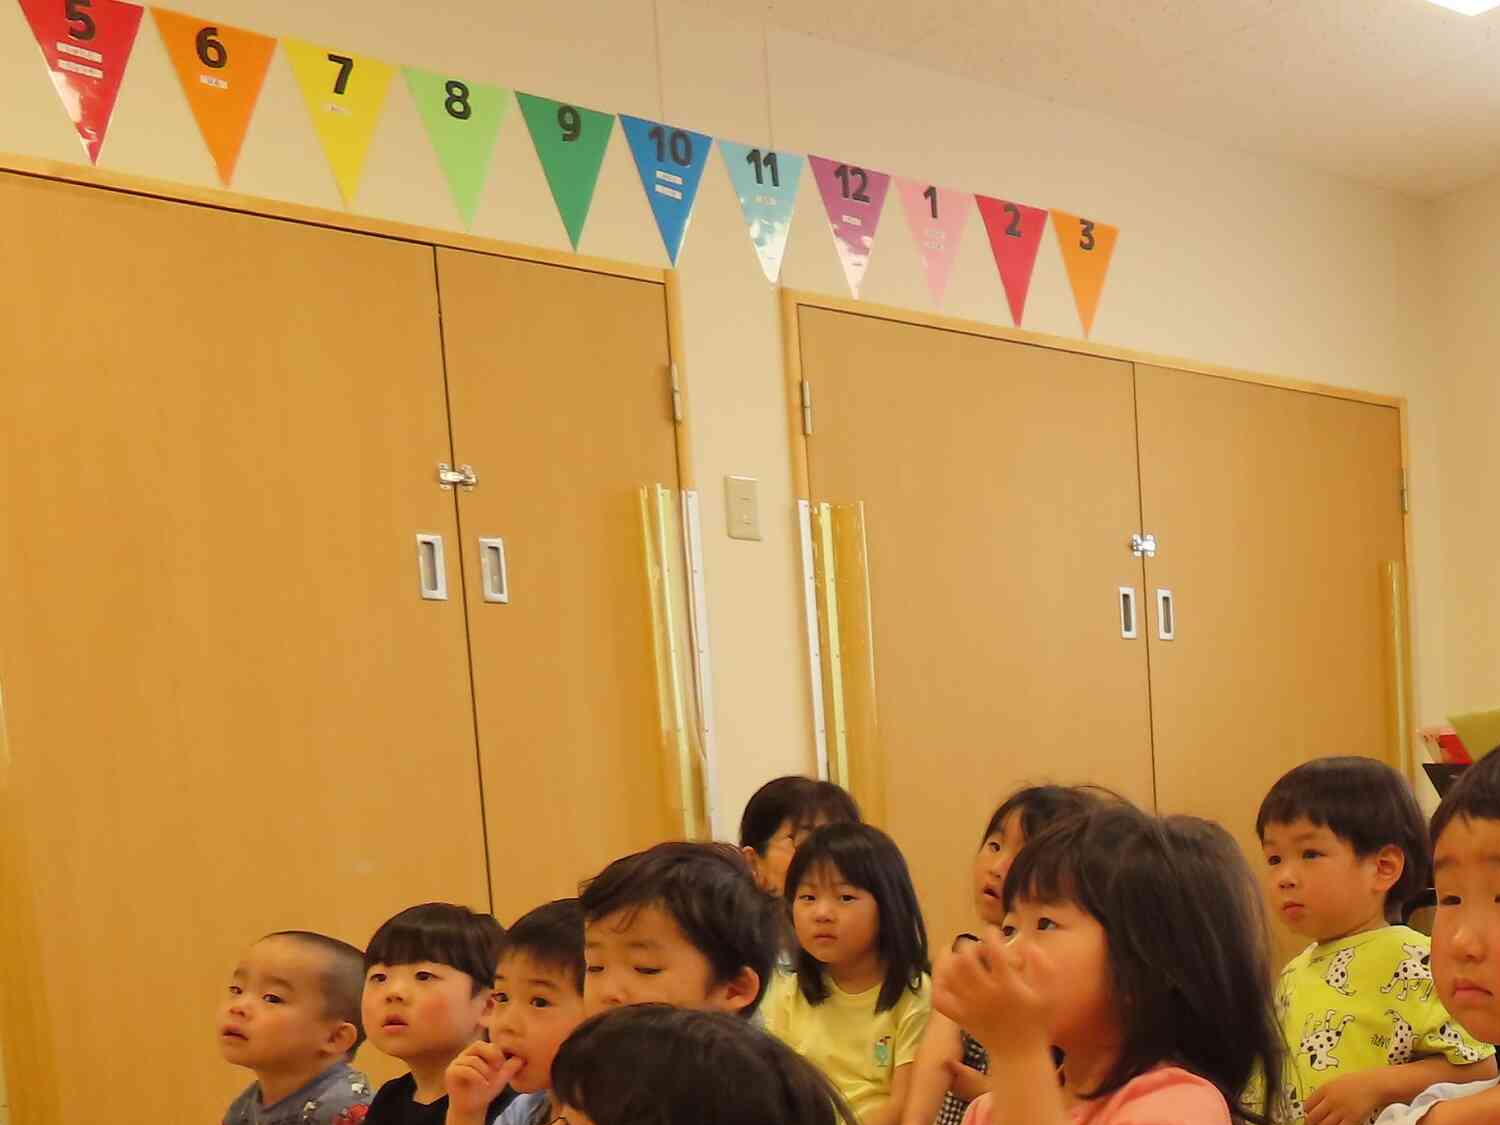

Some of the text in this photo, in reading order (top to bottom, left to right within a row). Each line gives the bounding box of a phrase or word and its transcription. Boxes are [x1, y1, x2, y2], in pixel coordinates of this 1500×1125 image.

[65, 0, 96, 40] 5
[195, 27, 228, 68] 6
[327, 53, 354, 95] 7
[445, 80, 472, 120] 8
[557, 105, 582, 142] 9
[649, 126, 693, 166] 10
[746, 149, 780, 187] 11
[834, 164, 871, 203] 12
[923, 186, 938, 218] 1
[1004, 202, 1023, 237] 2
[1080, 218, 1096, 251] 3
